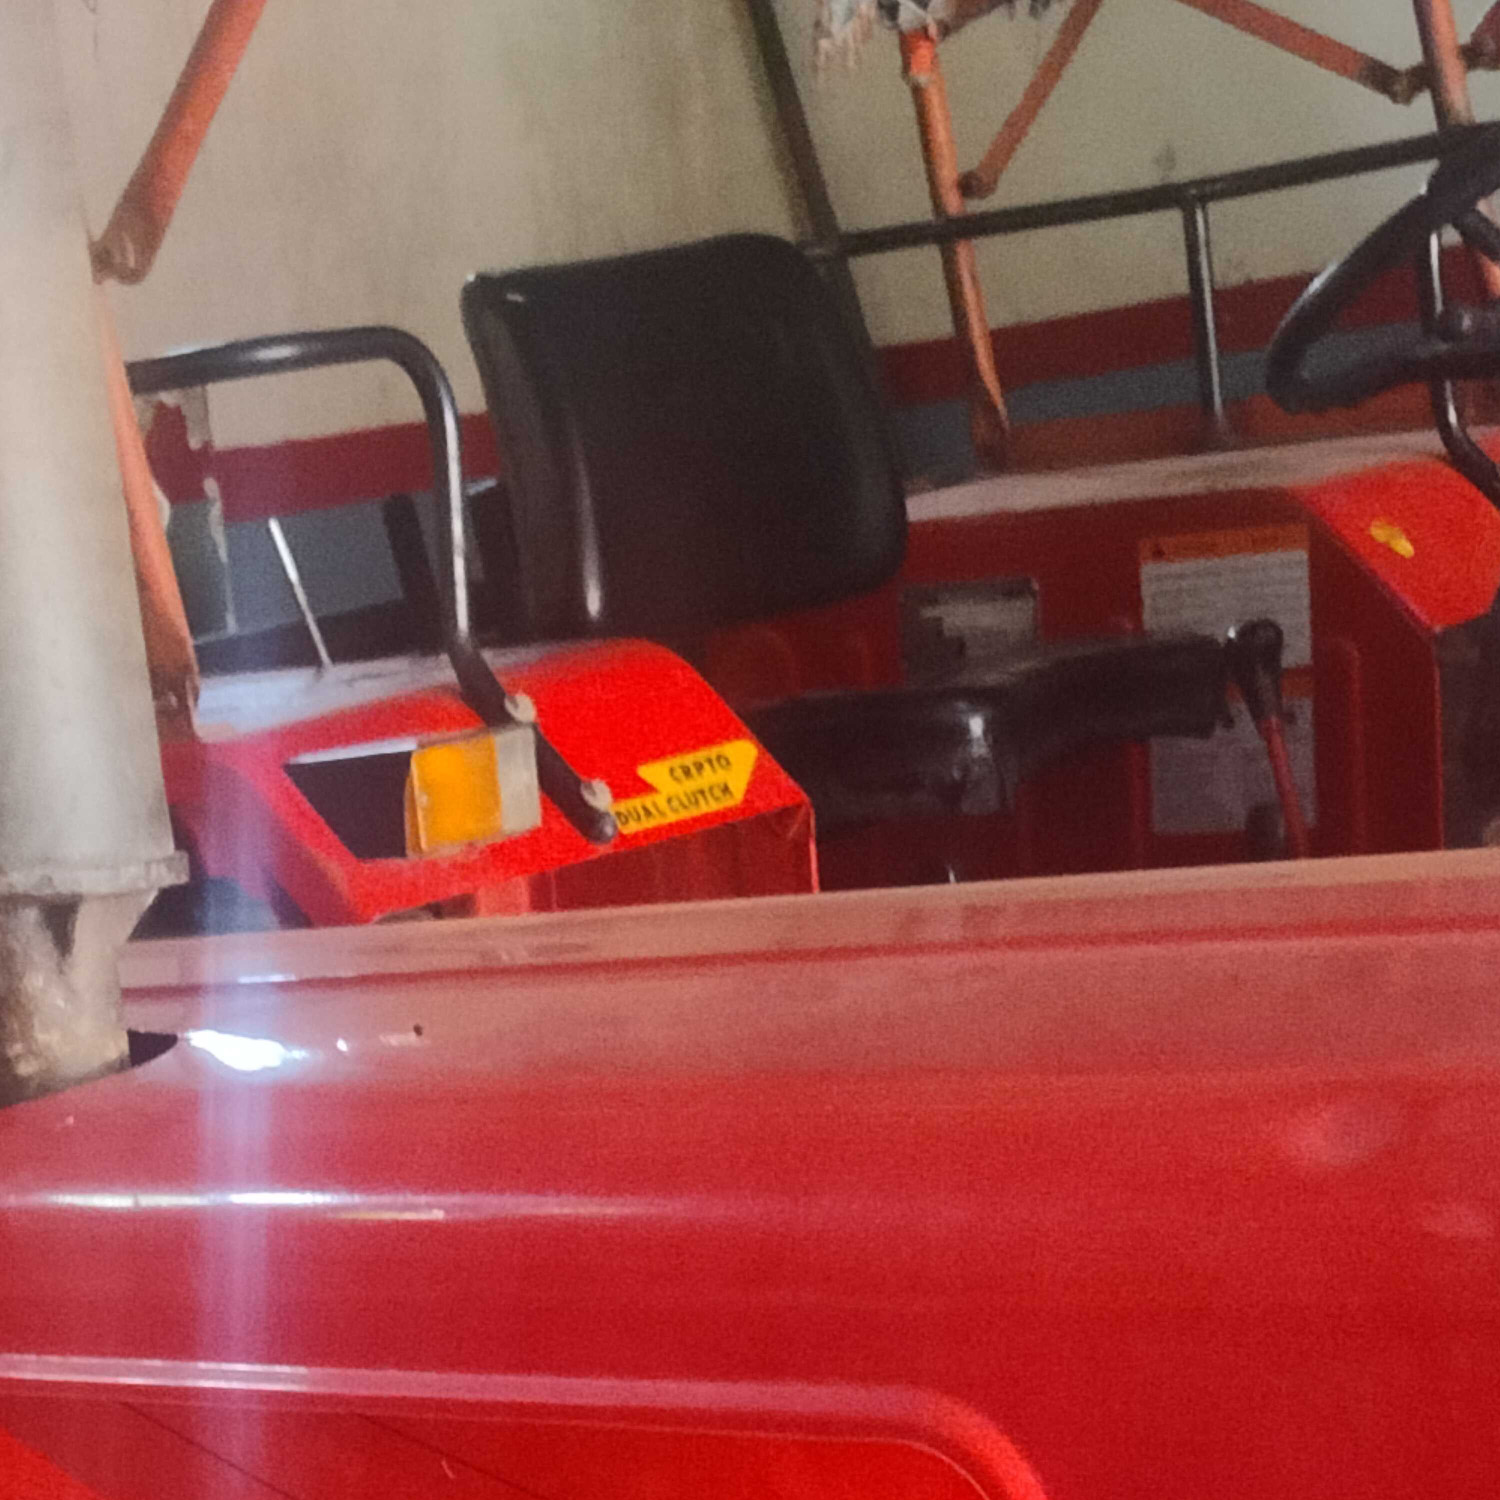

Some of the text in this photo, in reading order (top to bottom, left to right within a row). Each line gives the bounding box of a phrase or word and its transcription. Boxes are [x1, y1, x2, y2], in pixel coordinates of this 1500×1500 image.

[668, 753, 733, 783] CRPTO
[613, 782, 734, 826] DUAL CLUTCH
